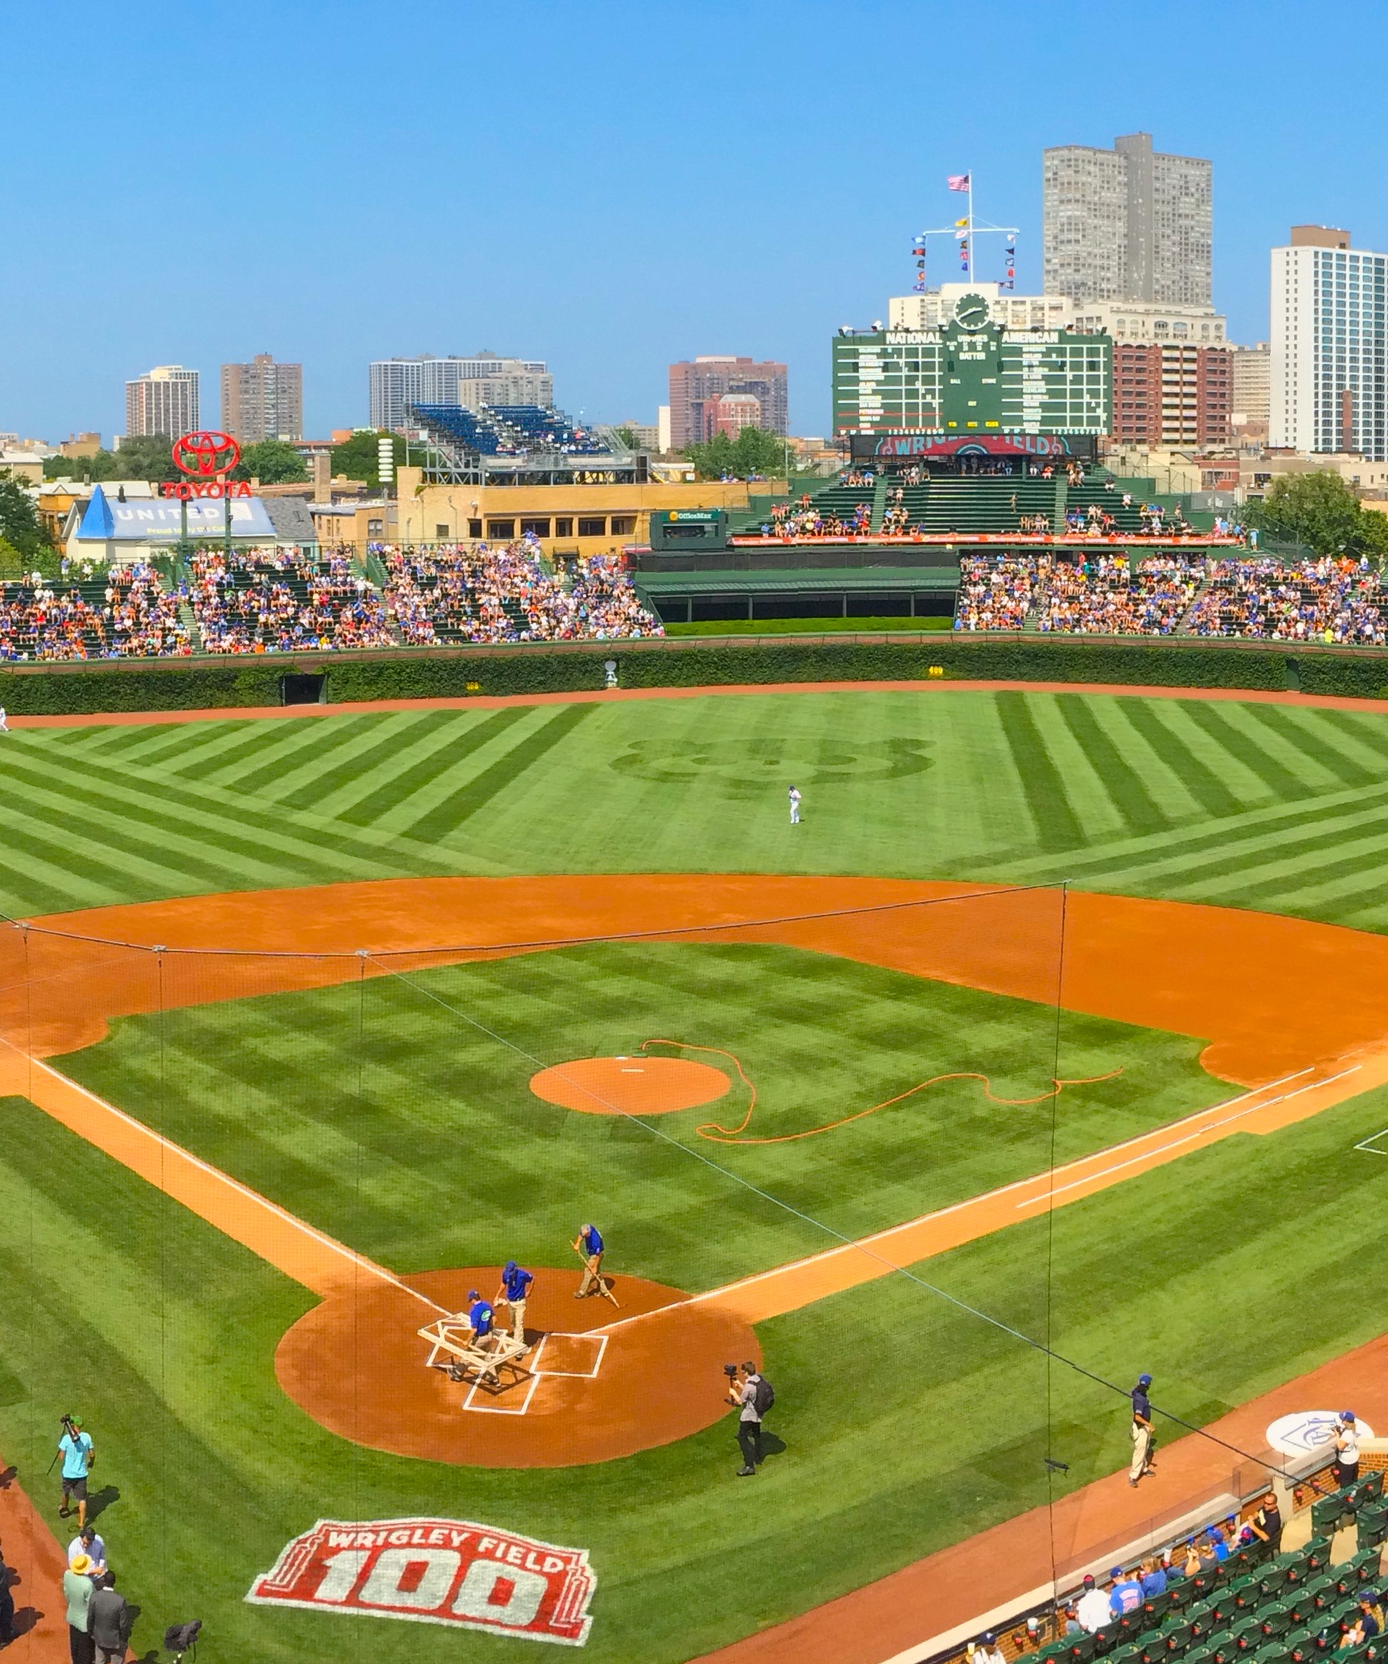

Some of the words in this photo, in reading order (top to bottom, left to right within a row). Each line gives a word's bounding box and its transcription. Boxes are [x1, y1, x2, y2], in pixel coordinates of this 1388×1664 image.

[886, 332, 943, 344] NATIONAL
[1001, 331, 1059, 343] AMERICAN
[959, 352, 986, 360] BATTER
[161, 481, 253, 500] TOYOTA
[117, 507, 221, 522] UNITED
[678, 512, 712, 520] OfficeMax
[326, 1529, 471, 1549] WRIGLEY
[477, 1538, 568, 1573] FIELD
[313, 1548, 550, 1627] 100
